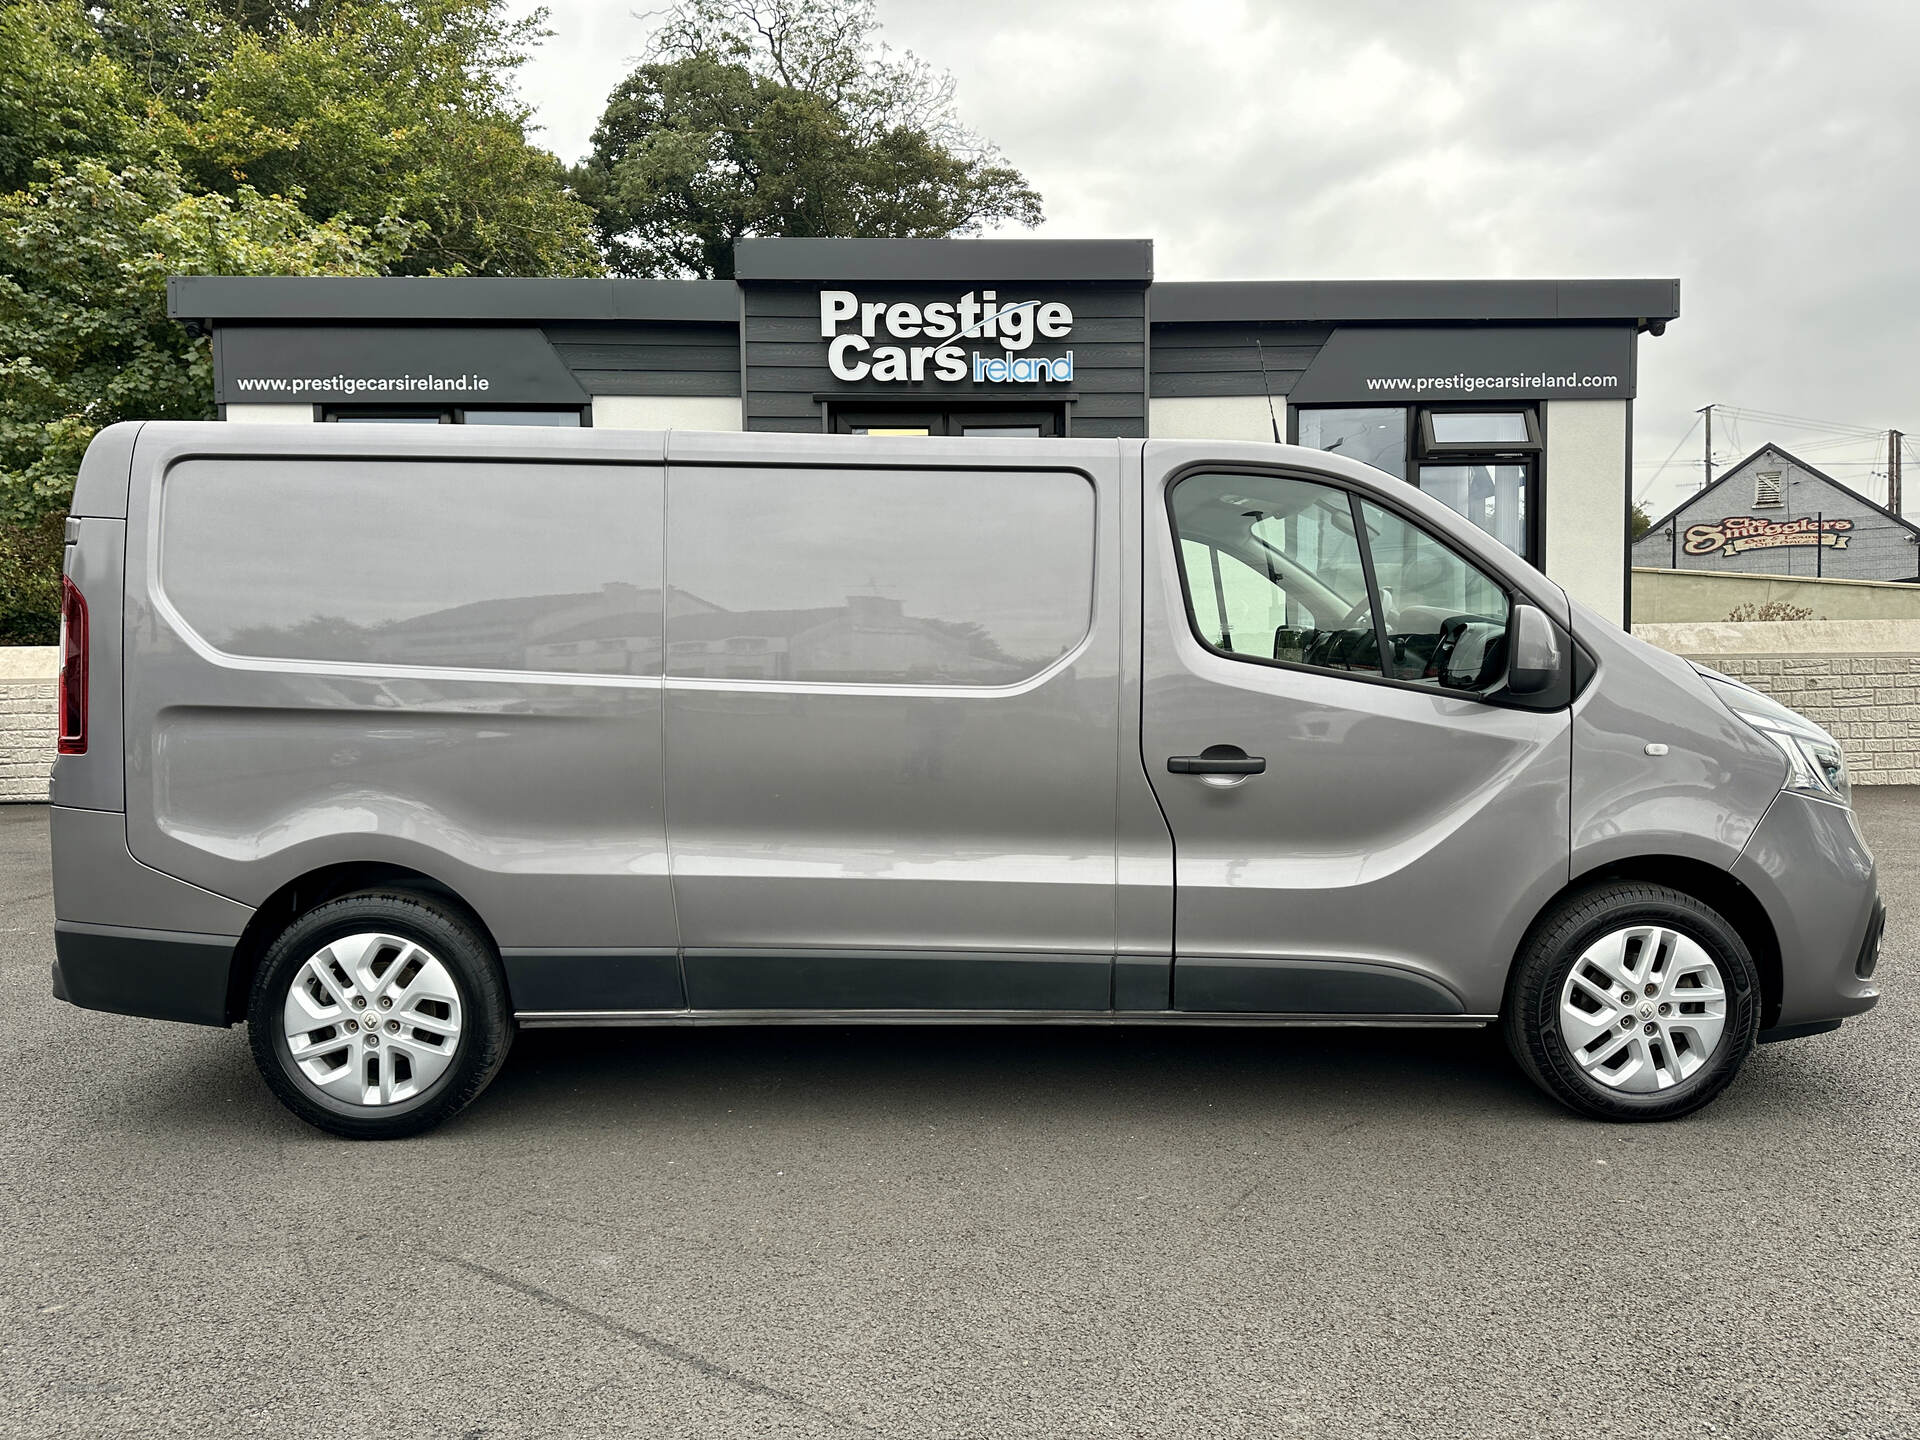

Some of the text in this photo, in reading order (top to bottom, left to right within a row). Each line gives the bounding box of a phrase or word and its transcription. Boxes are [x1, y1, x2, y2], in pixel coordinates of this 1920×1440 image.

[820, 290, 1074, 351] Prestige
[827, 333, 1074, 383] Cars Ireland
[236, 374, 490, 395] www.prestigecarsireland.ie
[1366, 371, 1618, 394] www.prestigecarsireland.com
[1684, 518, 1852, 554] Smugglers
[1724, 517, 1769, 529] The
